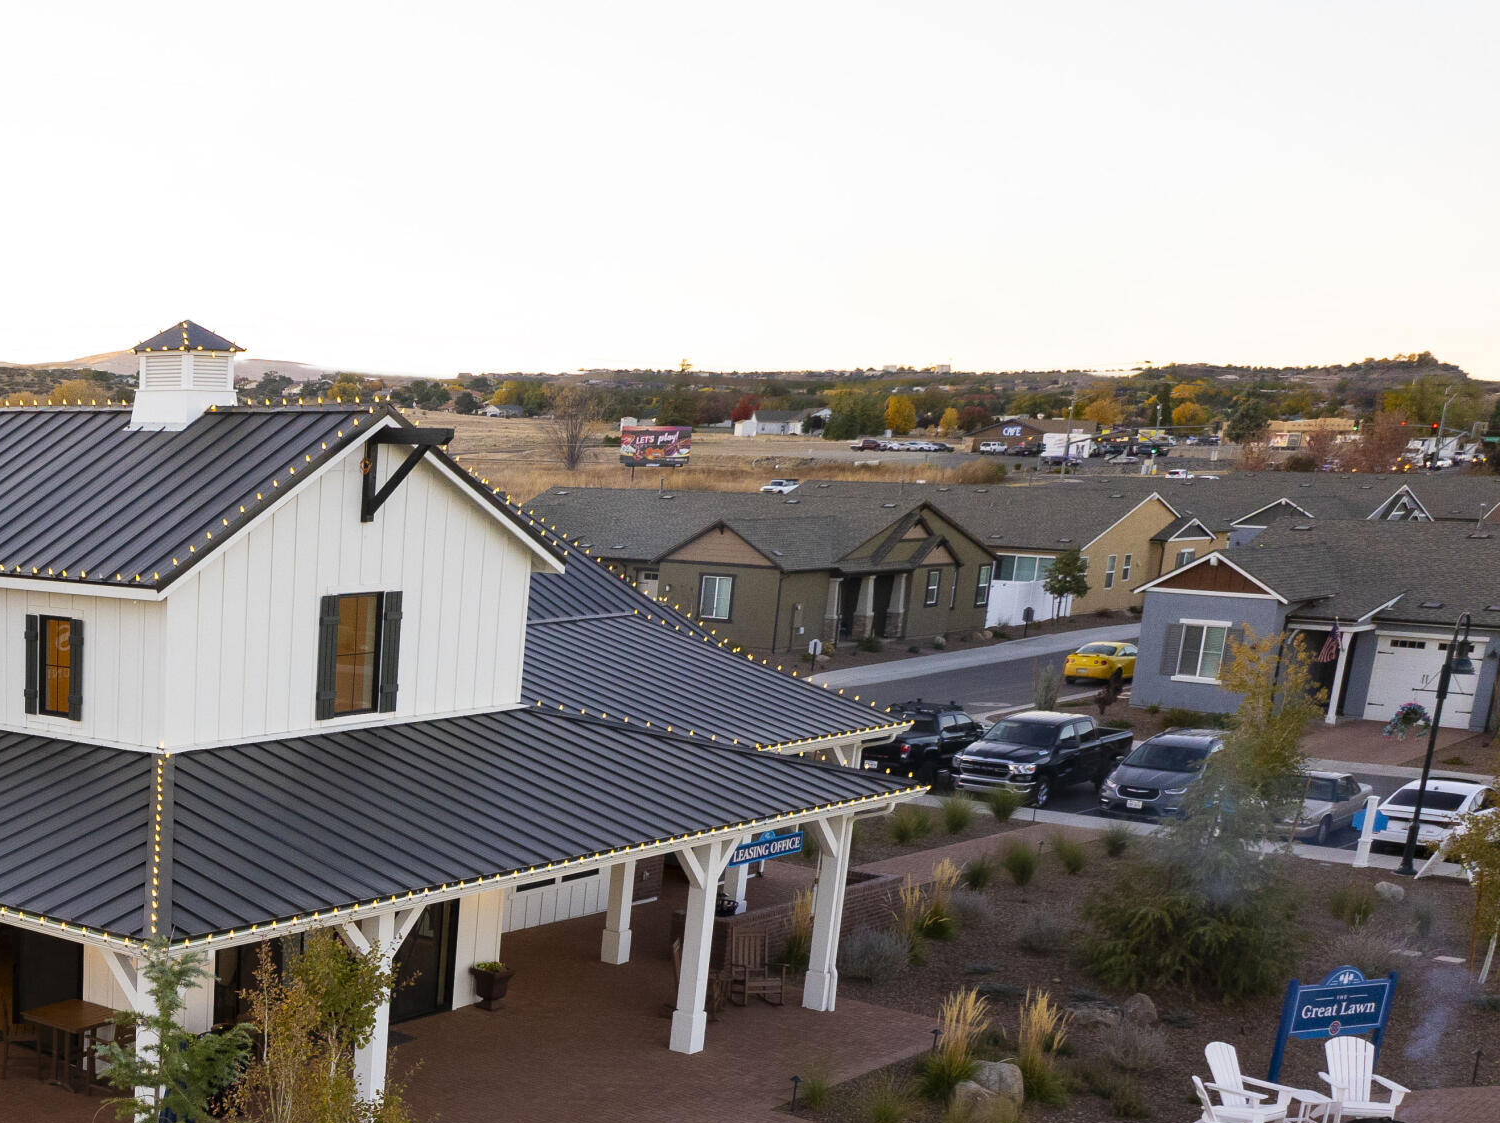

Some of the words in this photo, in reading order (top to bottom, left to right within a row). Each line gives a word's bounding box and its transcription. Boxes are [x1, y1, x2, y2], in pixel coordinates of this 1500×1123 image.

[636, 435, 655, 445] LET'S
[732, 843, 770, 863] LEASING
[770, 836, 801, 854] OFFICE
[1301, 1003, 1338, 1019] Great
[1340, 1001, 1376, 1016] Lawn
